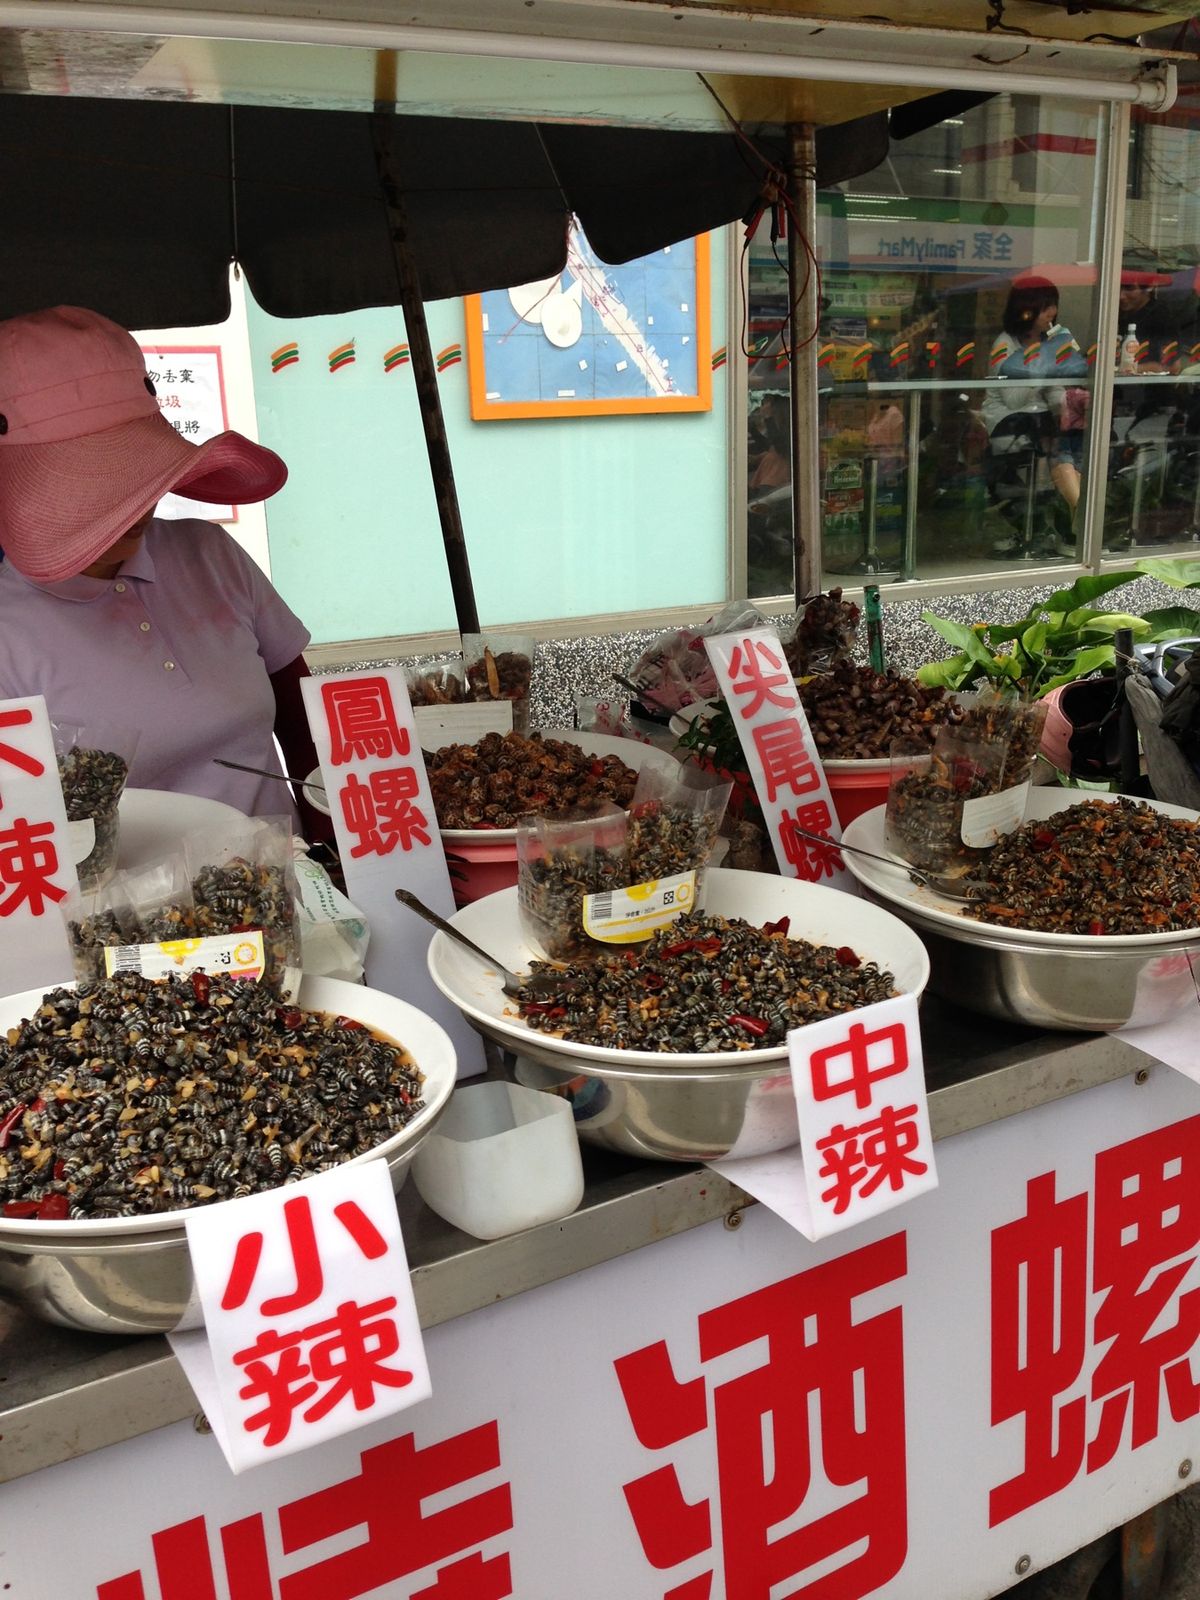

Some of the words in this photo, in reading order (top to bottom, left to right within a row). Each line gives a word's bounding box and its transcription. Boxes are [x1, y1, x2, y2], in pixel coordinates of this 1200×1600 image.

[320, 675, 432, 859] 鳳螺
[728, 638, 846, 883] 尖尾螺
[809, 1022, 928, 1216] 中辣
[220, 1196, 414, 1447] 小辣
